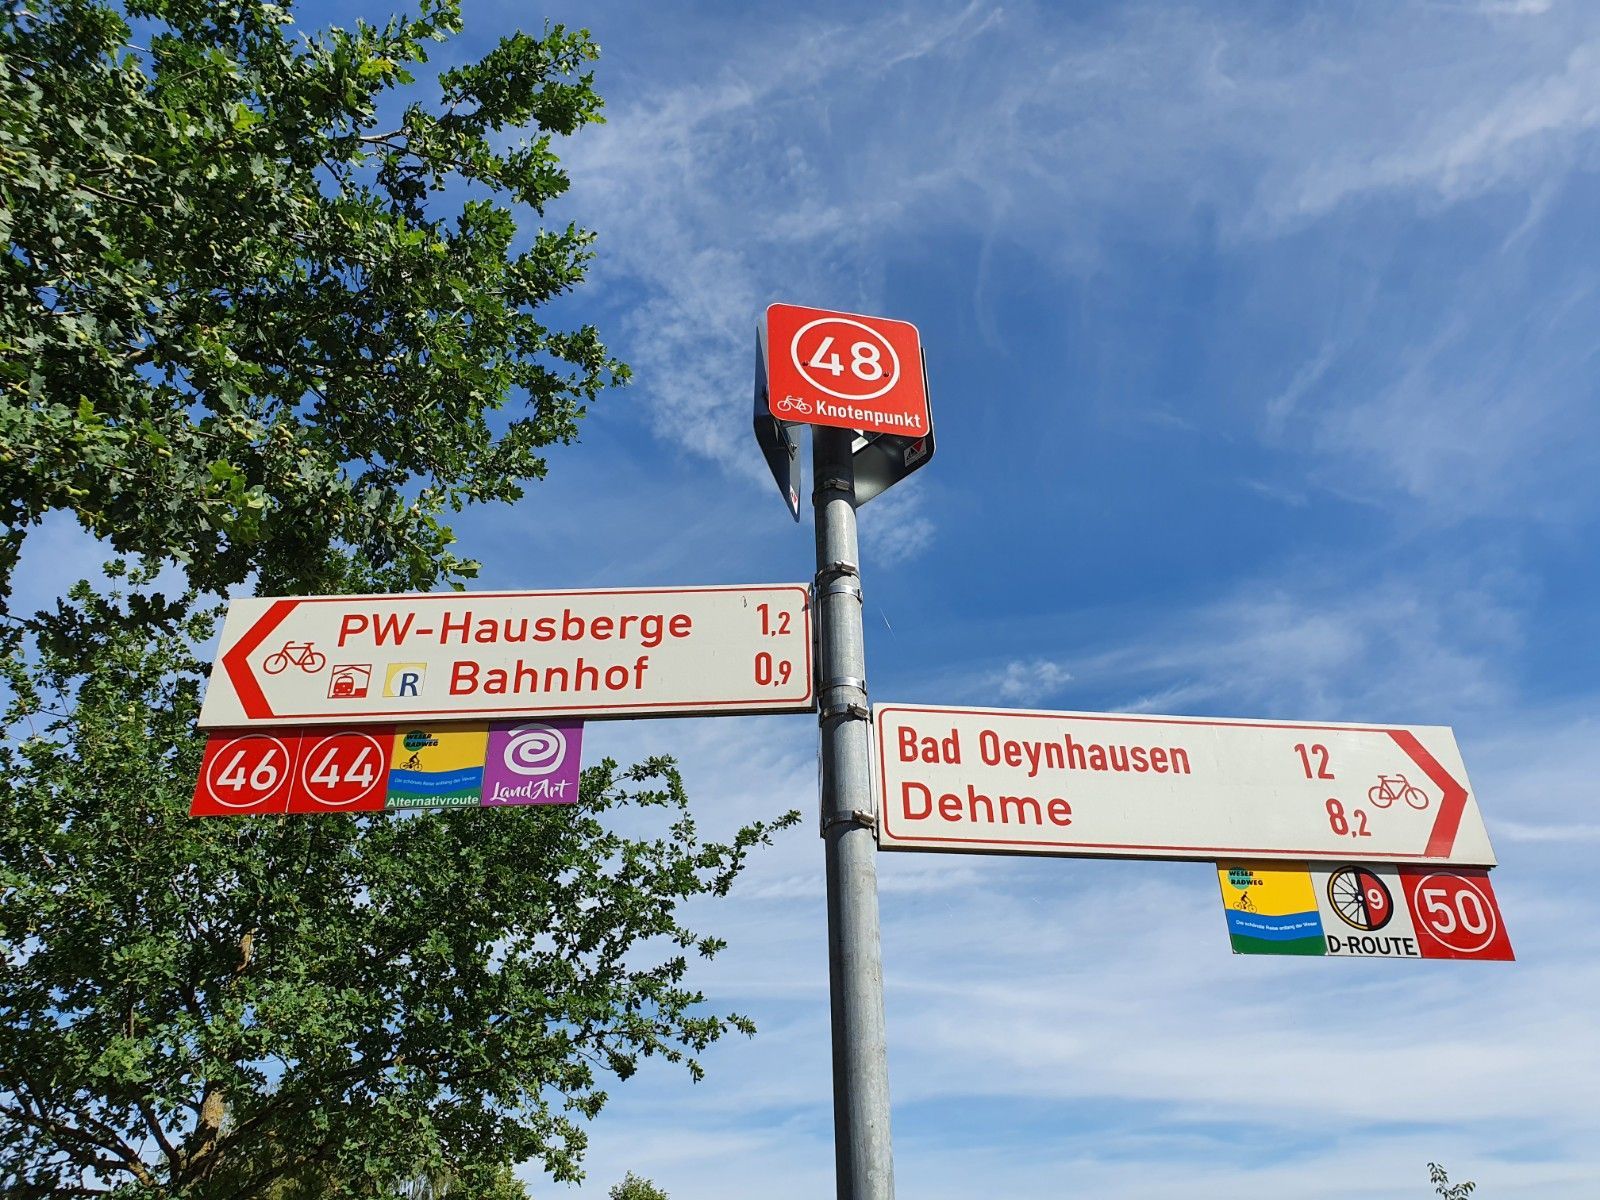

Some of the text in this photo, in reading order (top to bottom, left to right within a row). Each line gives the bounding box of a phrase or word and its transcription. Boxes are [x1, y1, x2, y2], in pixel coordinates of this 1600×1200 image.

[809, 336, 884, 381] 48
[816, 400, 921, 429] Knotenpunkt
[338, 603, 791, 648] PW-Hausberge 1,2
[399, 651, 792, 697] R Bahnhof 0,9
[216, 749, 278, 791] 46
[310, 746, 374, 789] 44
[897, 726, 1335, 780] Bad Oeynhausen 12
[386, 795, 479, 808] Alternativroute
[901, 781, 1372, 838] Dehme 8,2
[1228, 869, 1254, 877] WESER
[1367, 888, 1384, 910] 9
[1422, 888, 1488, 935] 50
[1327, 935, 1418, 956] D-ROUTE
